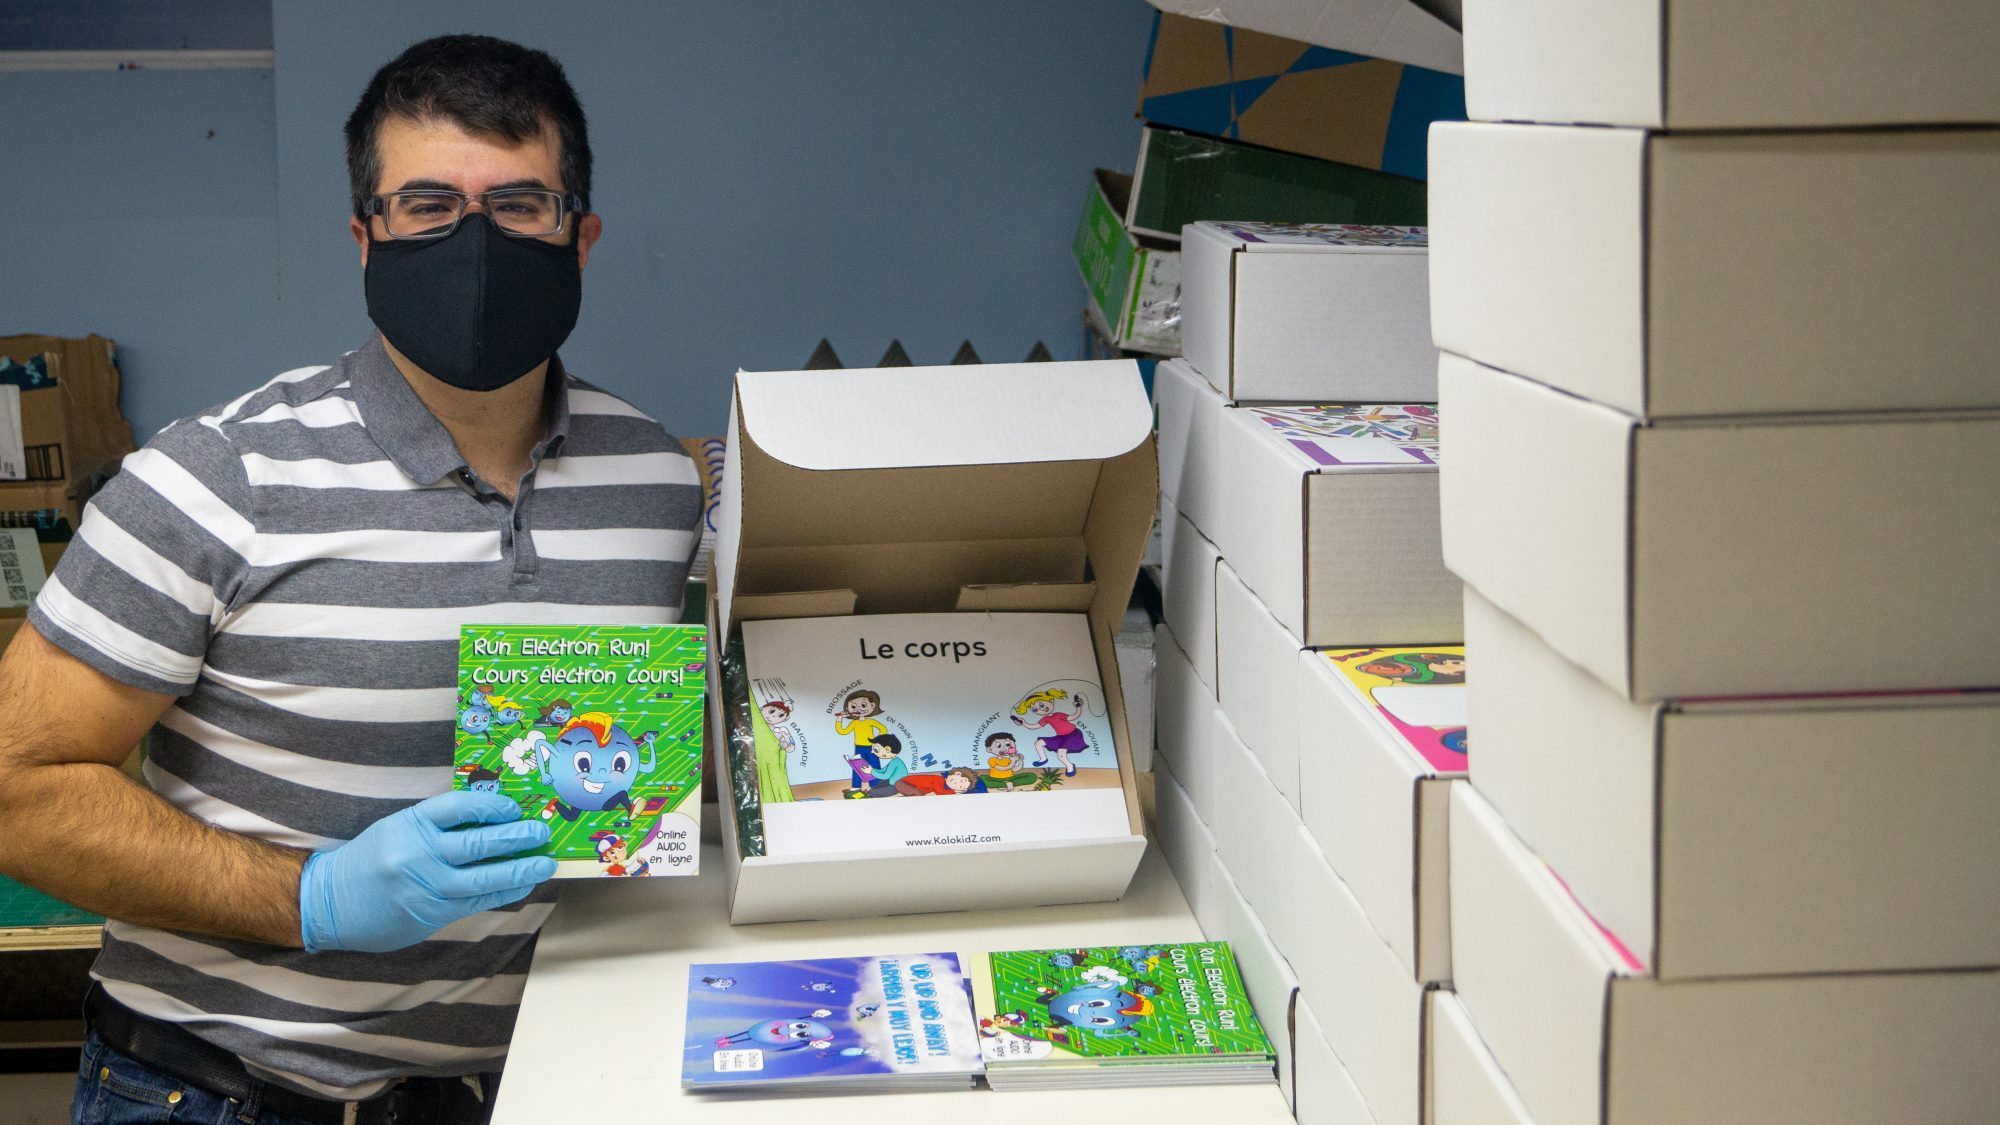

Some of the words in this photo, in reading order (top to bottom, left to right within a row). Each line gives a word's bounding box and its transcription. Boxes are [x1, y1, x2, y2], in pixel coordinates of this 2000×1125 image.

[473, 638, 510, 656] Run
[522, 638, 599, 656] Electron
[609, 638, 650, 658] Run!
[860, 638, 894, 659] Le
[904, 641, 987, 663] corps
[472, 666, 528, 684] Cours
[539, 665, 616, 684] électron
[626, 667, 684, 687] cours!
[825, 678, 864, 714] BROSSAGE
[886, 716, 896, 724] EN
[897, 722, 912, 739] TRAIN
[973, 711, 1001, 753] MANGEANT
[790, 722, 809, 767] BAIGNADE
[1077, 720, 1087, 730] EN
[1086, 730, 1100, 757] JOUANT
[972, 754, 980, 766] EN
[656, 830, 687, 839] Online
[905, 834, 1001, 846] www.KolokidZ.com
[656, 842, 686, 851] AUDIO
[650, 856, 662, 864] en
[668, 854, 692, 867] ligne
[1170, 948, 1189, 973] Cours
[1199, 948, 1215, 964] Run
[913, 982, 937, 998] UP
[1203, 968, 1227, 1005] Electron
[1217, 1010, 1240, 1030] Run!
